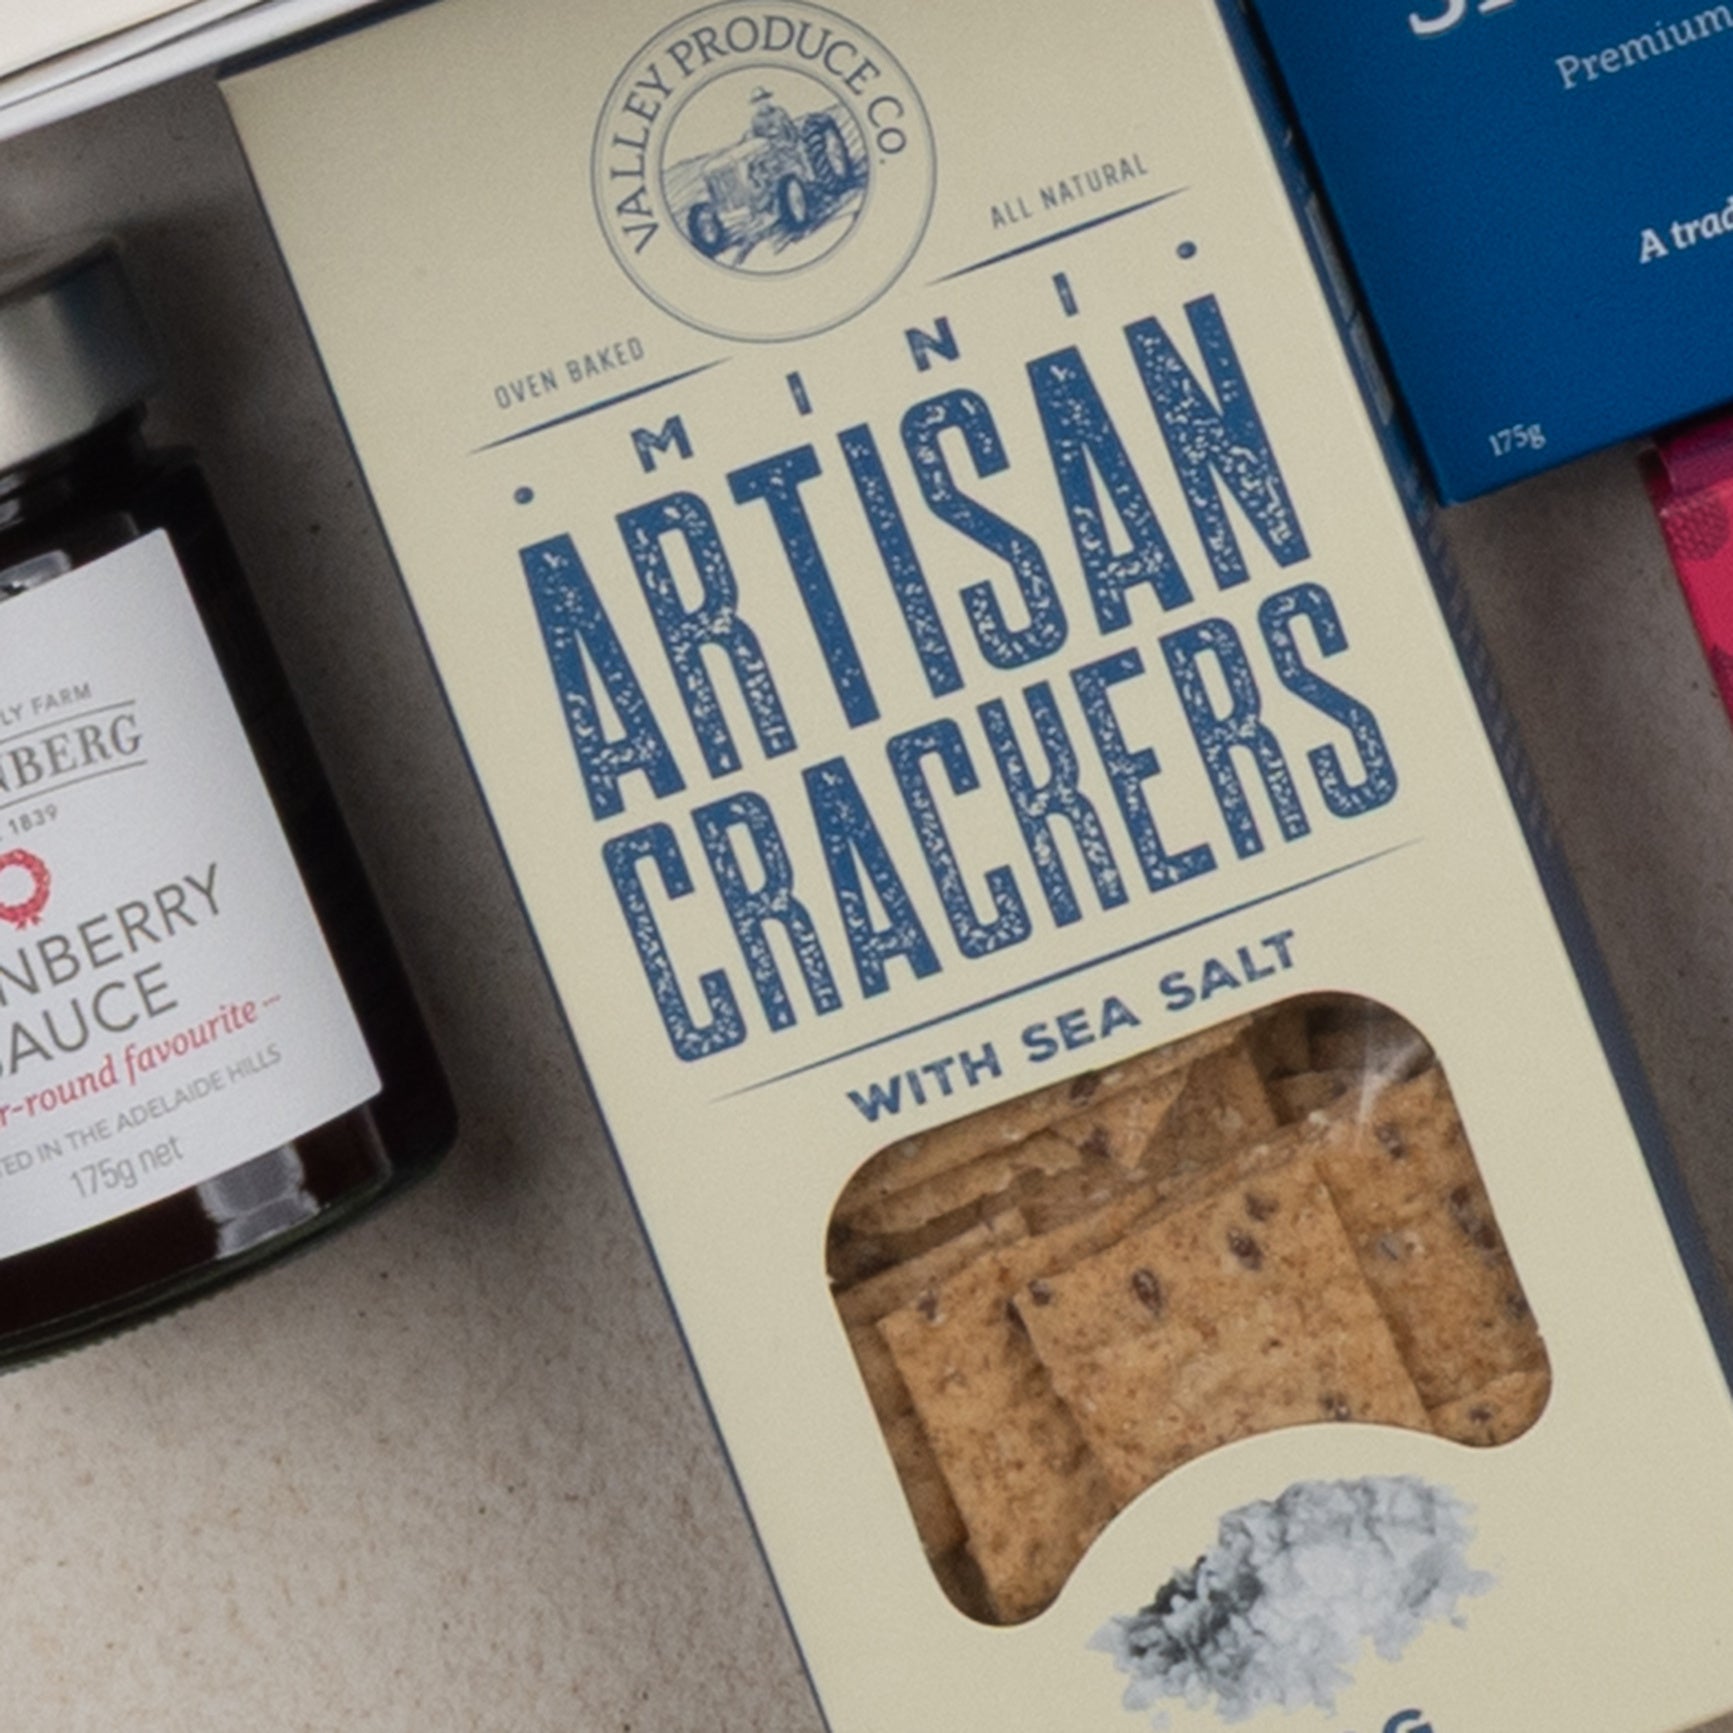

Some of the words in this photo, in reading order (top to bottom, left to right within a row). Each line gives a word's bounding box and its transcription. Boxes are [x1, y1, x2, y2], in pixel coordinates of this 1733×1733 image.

[1555, 4, 1733, 90] Premium
[610, 63, 674, 254] VALLEY
[666, 14, 882, 96] PRODUCE
[867, 95, 908, 165] CO.
[990, 196, 1033, 230] ALL
[1039, 153, 1149, 211] NATURAL
[1639, 227, 1669, 265] A
[494, 367, 559, 411] OVEN
[566, 335, 646, 384] BAKED
[1488, 423, 1547, 457] 175g
[517, 292, 1312, 822] ARTISAN
[31, 682, 92, 715] FARM
[8, 803, 58, 835] 1839
[601, 582, 1399, 1064] CRACKERS
[0, 962, 179, 1077] AUCE
[121, 1000, 259, 1087] favourite
[846, 1041, 1003, 1124] WITH
[1021, 995, 1142, 1064] SEA
[1158, 929, 1295, 1013] SALT
[36, 1139, 63, 1164] IN
[65, 1118, 113, 1151] THE
[116, 1069, 225, 1134] ADELAIDE
[227, 1042, 283, 1084] HILLS
[70, 1154, 138, 1199] 175g
[138, 1134, 185, 1176] net
